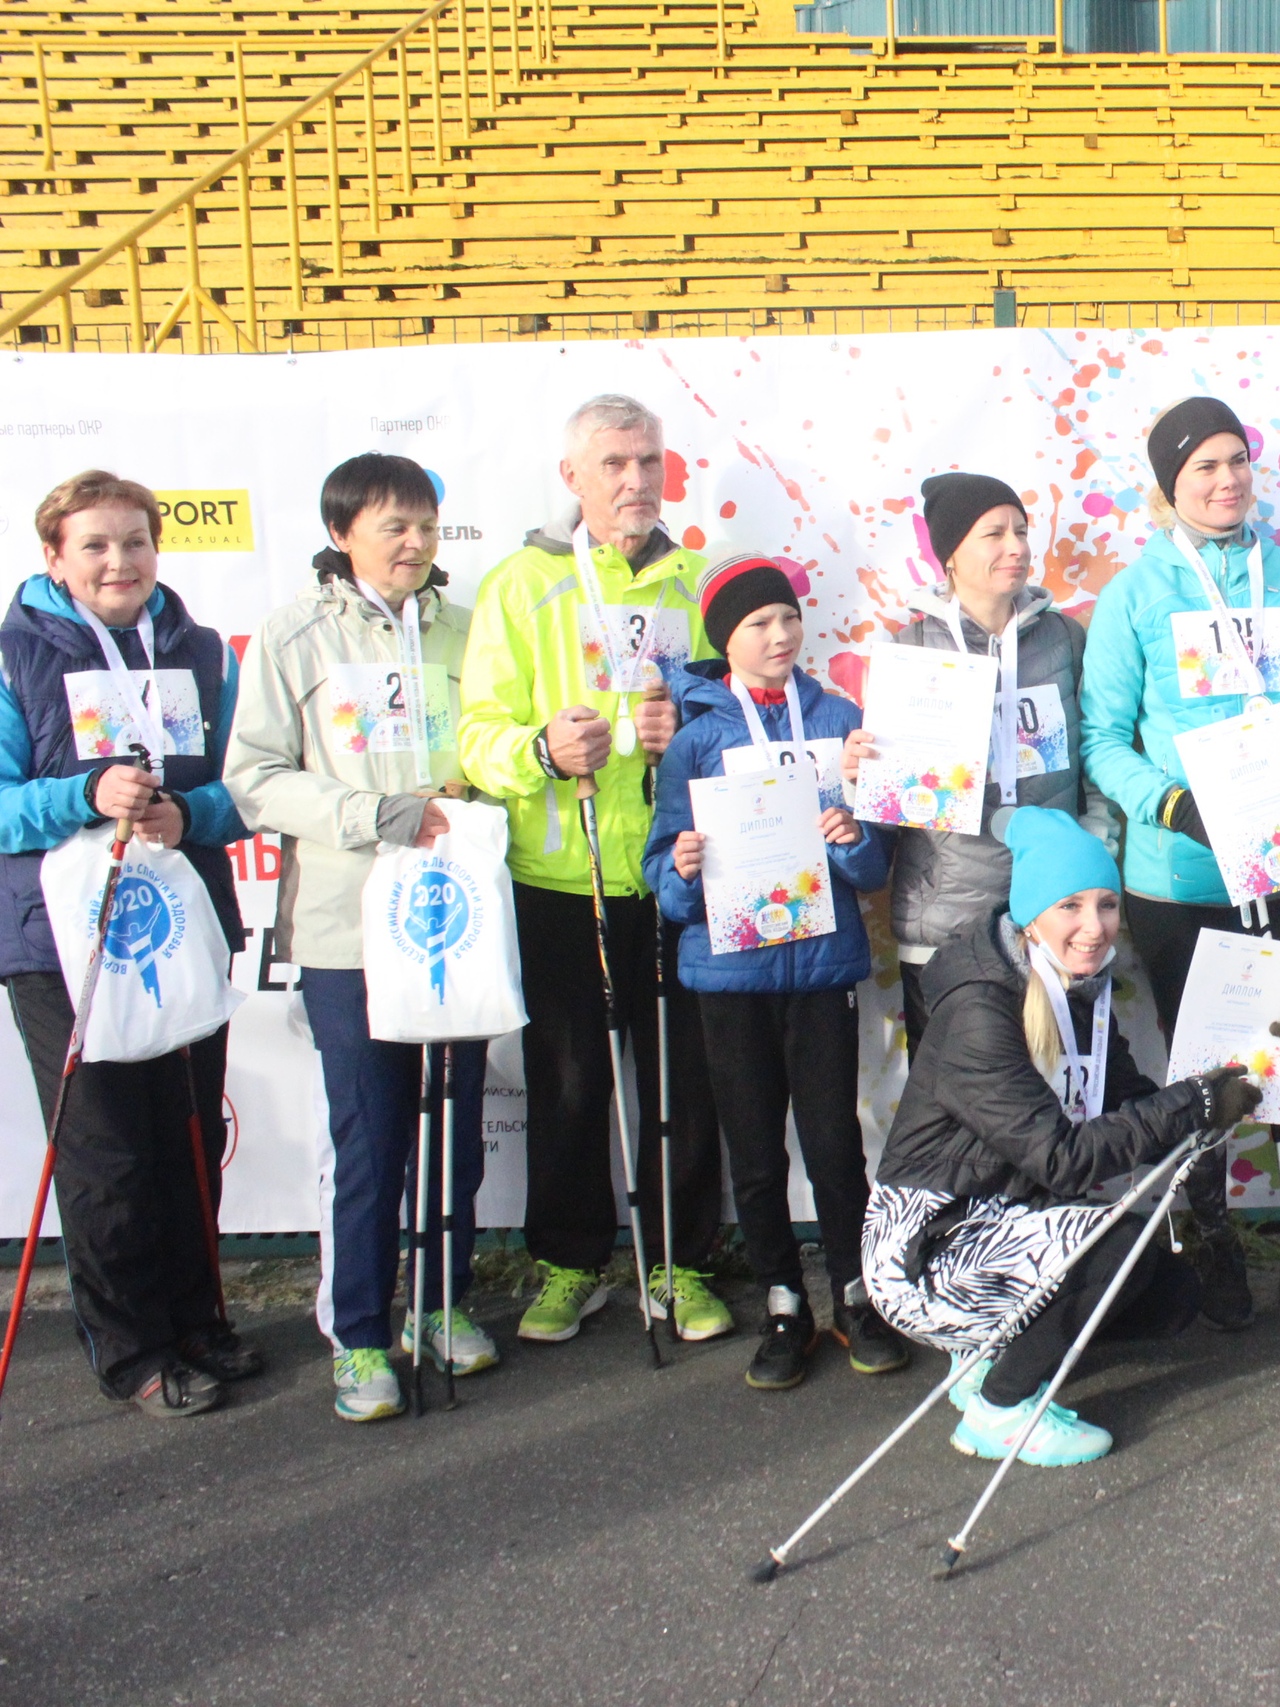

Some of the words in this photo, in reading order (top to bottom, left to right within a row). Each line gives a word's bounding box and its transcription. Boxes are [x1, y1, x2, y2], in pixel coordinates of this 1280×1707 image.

[17, 423, 76, 439] партнеры
[78, 419, 103, 436] ОКР
[370, 416, 423, 435] Партнер
[171, 536, 242, 545] CASUAL
[629, 614, 646, 651] 3
[386, 672, 405, 709] 2
[1230, 757, 1270, 781] ДИПЛОМ
[740, 816, 784, 834] ДИПЛОМ
[1221, 983, 1263, 998] ДИПЛОМ
